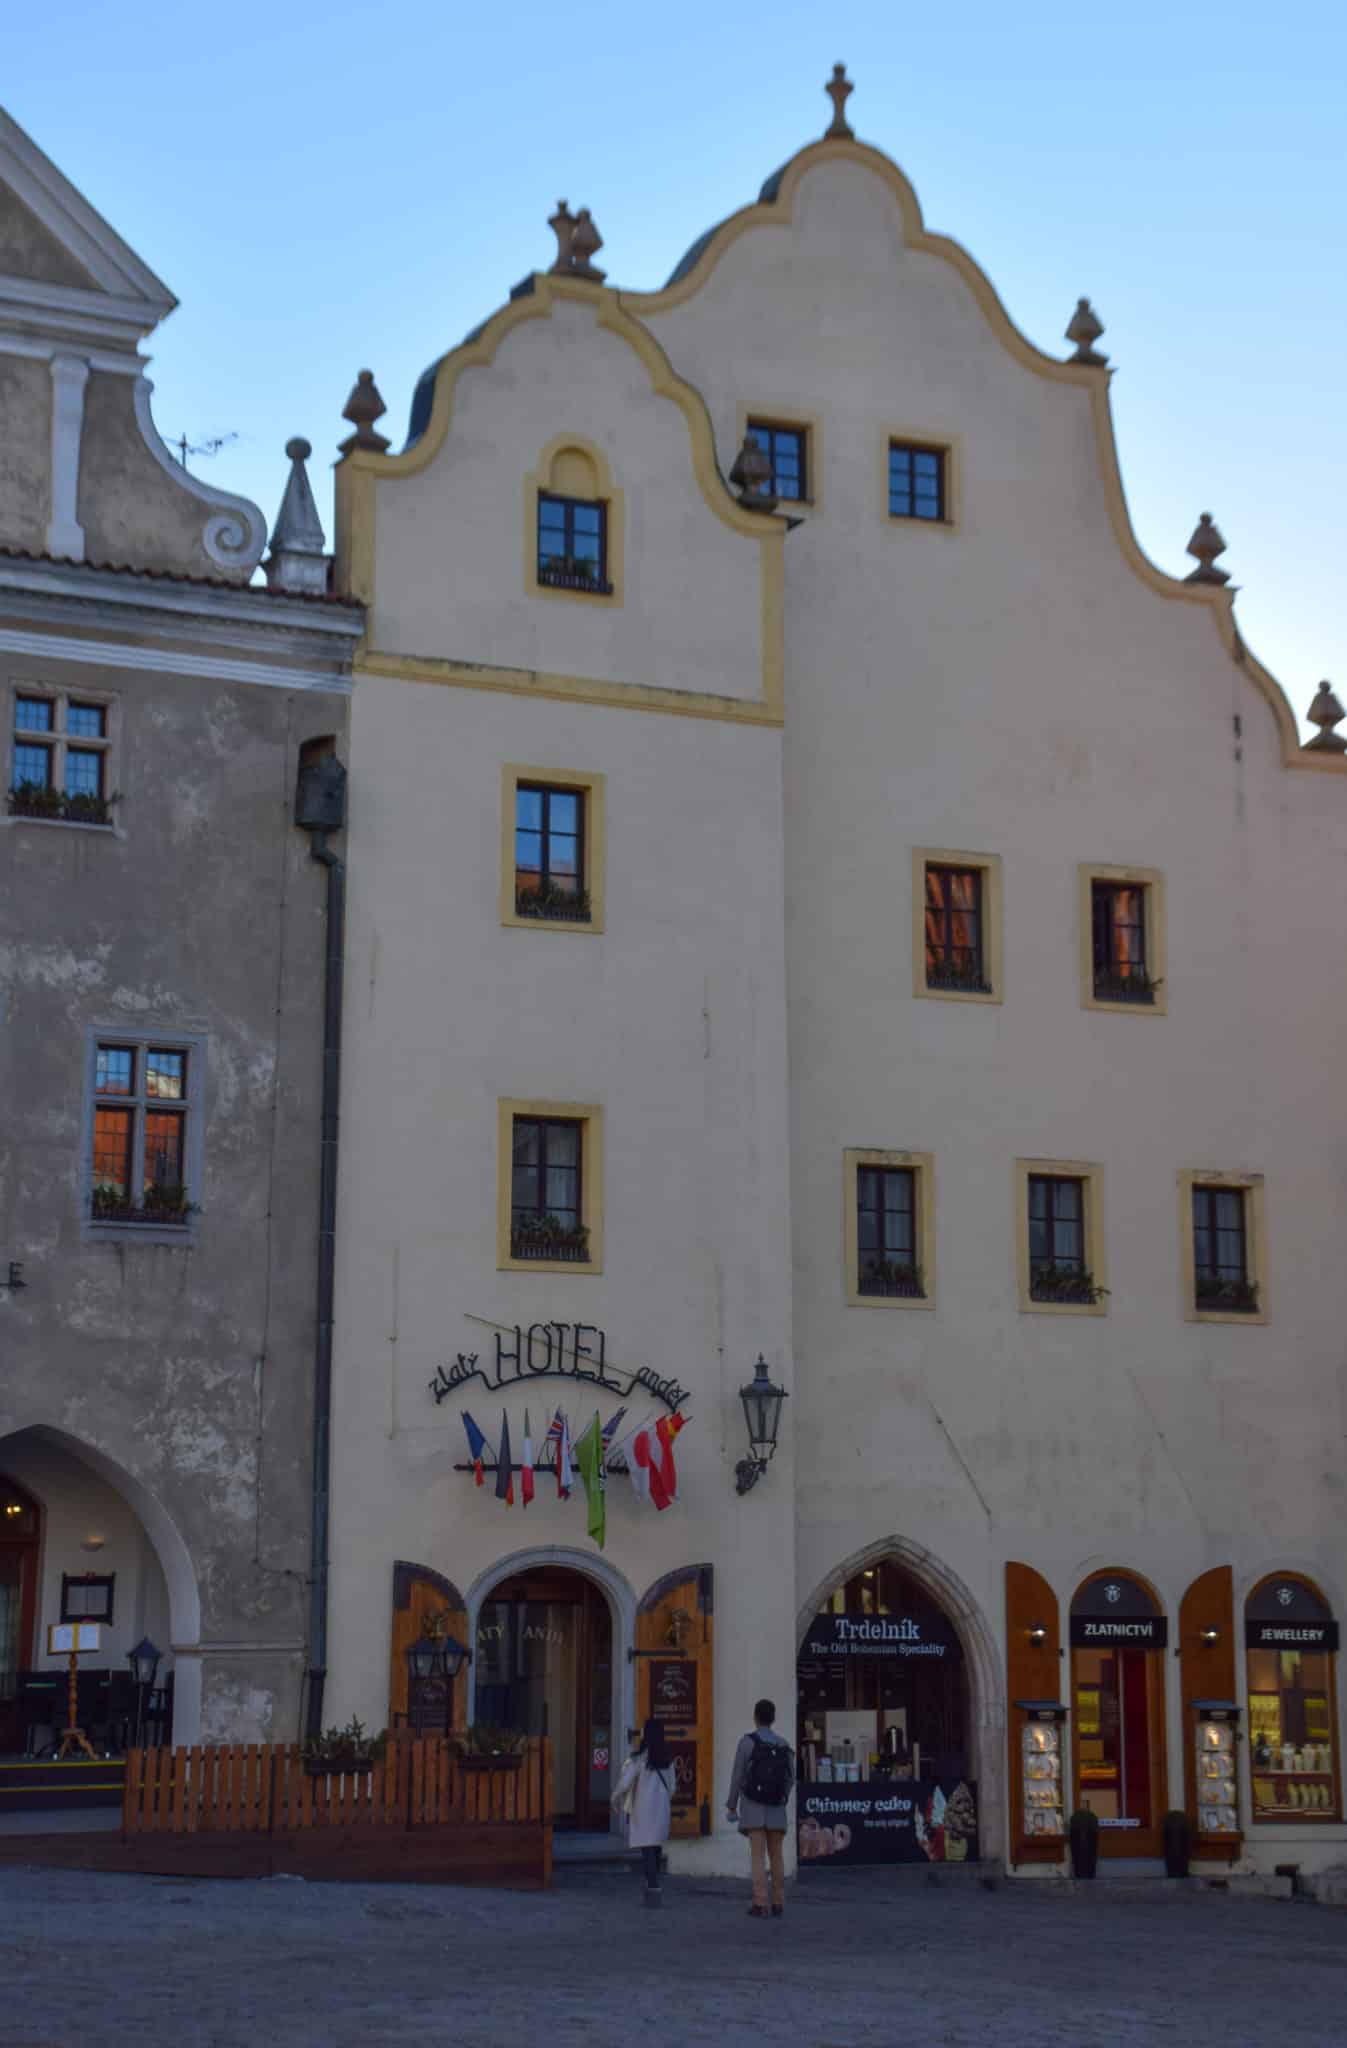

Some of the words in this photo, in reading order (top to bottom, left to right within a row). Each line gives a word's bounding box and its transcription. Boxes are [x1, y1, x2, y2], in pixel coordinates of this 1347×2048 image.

[494, 1321, 621, 1387] HOTEL
[835, 1618, 921, 1640] Trdelník
[1084, 1621, 1153, 1637] ZLATNICTVÍ
[1260, 1628, 1324, 1641] JEWELLERY
[900, 1642, 946, 1657] Speciality
